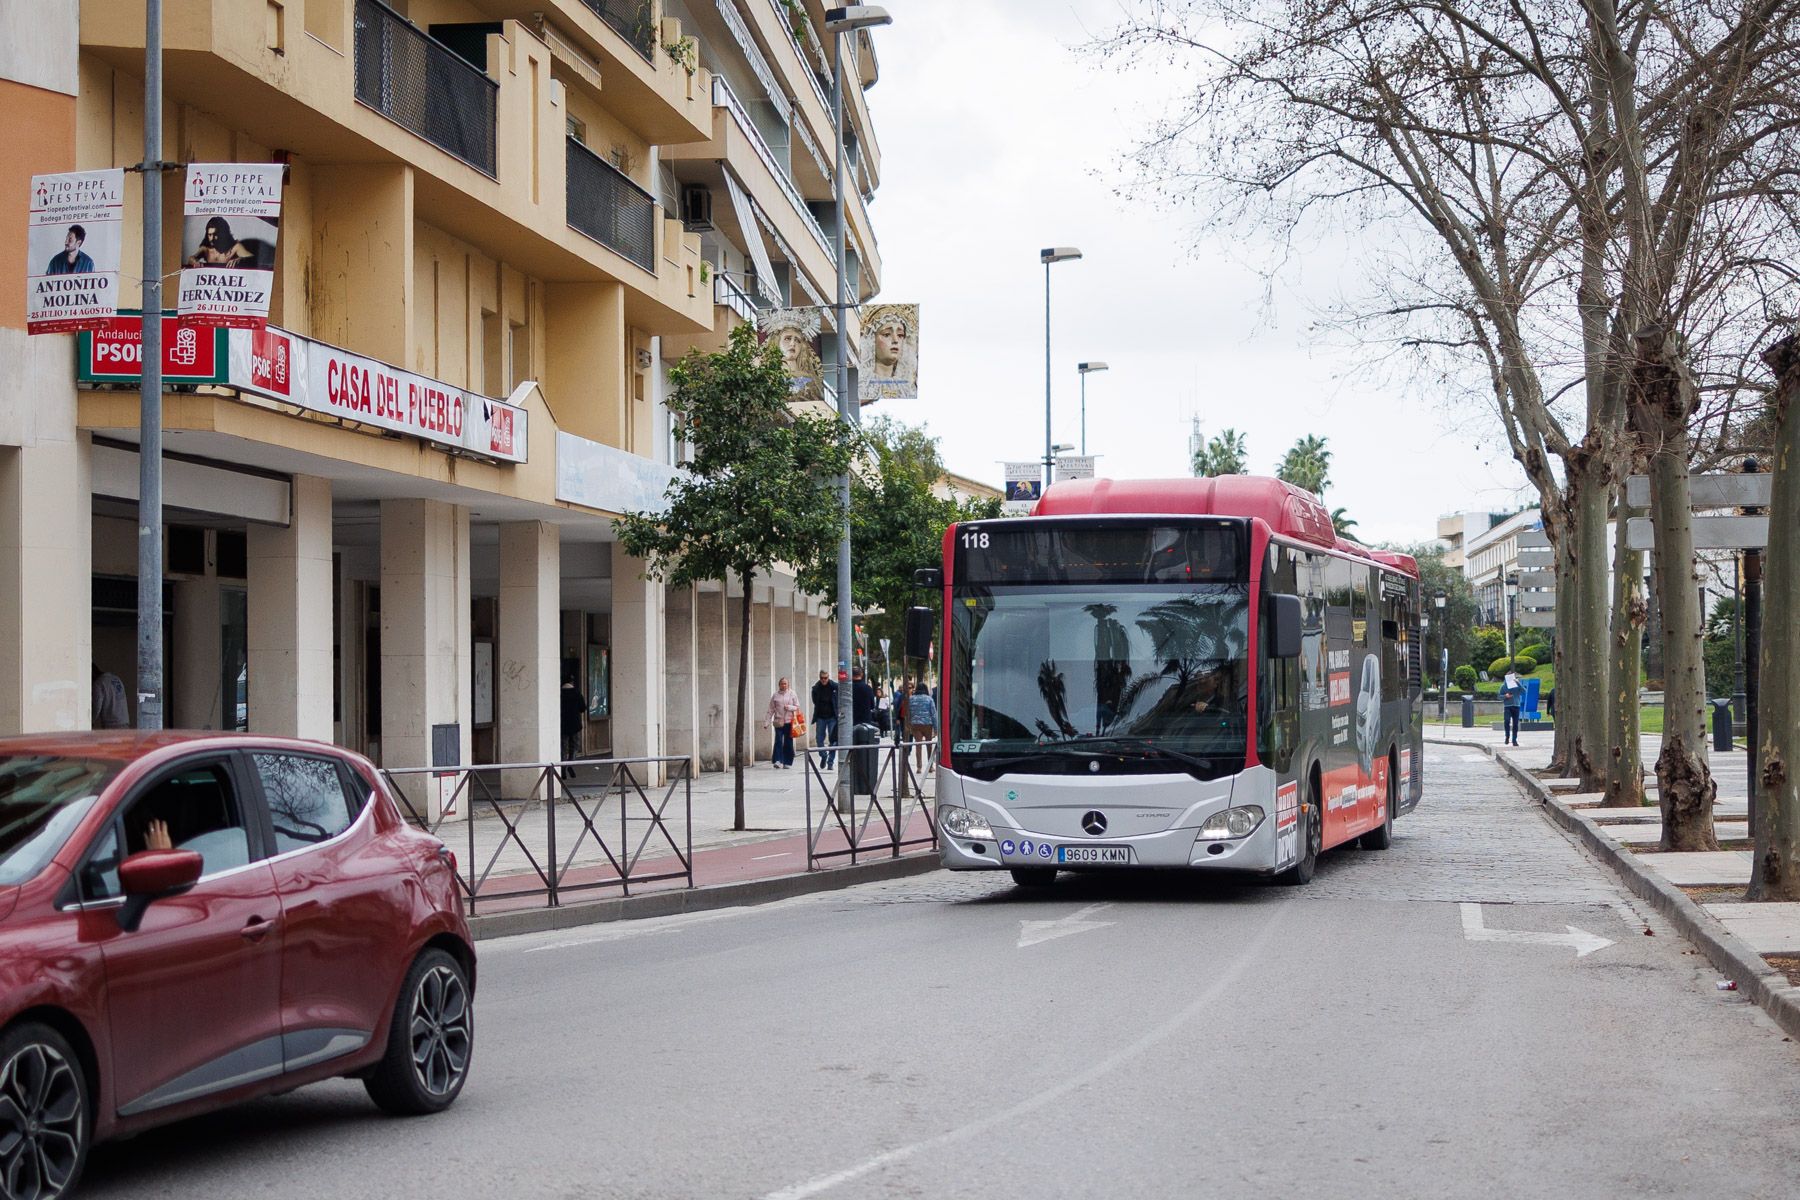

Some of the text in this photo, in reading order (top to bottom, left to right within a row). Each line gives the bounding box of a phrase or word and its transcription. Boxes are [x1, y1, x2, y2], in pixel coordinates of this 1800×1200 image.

[208, 174, 264, 184] TIO PEPE
[50, 180, 106, 192] TIO PEPE
[202, 198, 262, 206] tiopepefestival.com
[47, 204, 105, 214] tiopepefestival.com
[36, 276, 108, 294] ANTOÑITO
[196, 274, 247, 288] ISRAEL
[42, 293, 98, 308] MOLINA
[182, 287, 264, 304] FERNÁNDEZ
[40, 310, 63, 318] JULIO
[79, 307, 112, 315] AGOSTO
[208, 304, 238, 312] JULIO
[97, 329, 142, 340] Andalucí
[252, 354, 271, 378] PSOE
[328, 358, 463, 437] CASA DEL PUEBLO
[962, 532, 990, 549] 118
[1066, 849, 1126, 860] 9609 KMN
